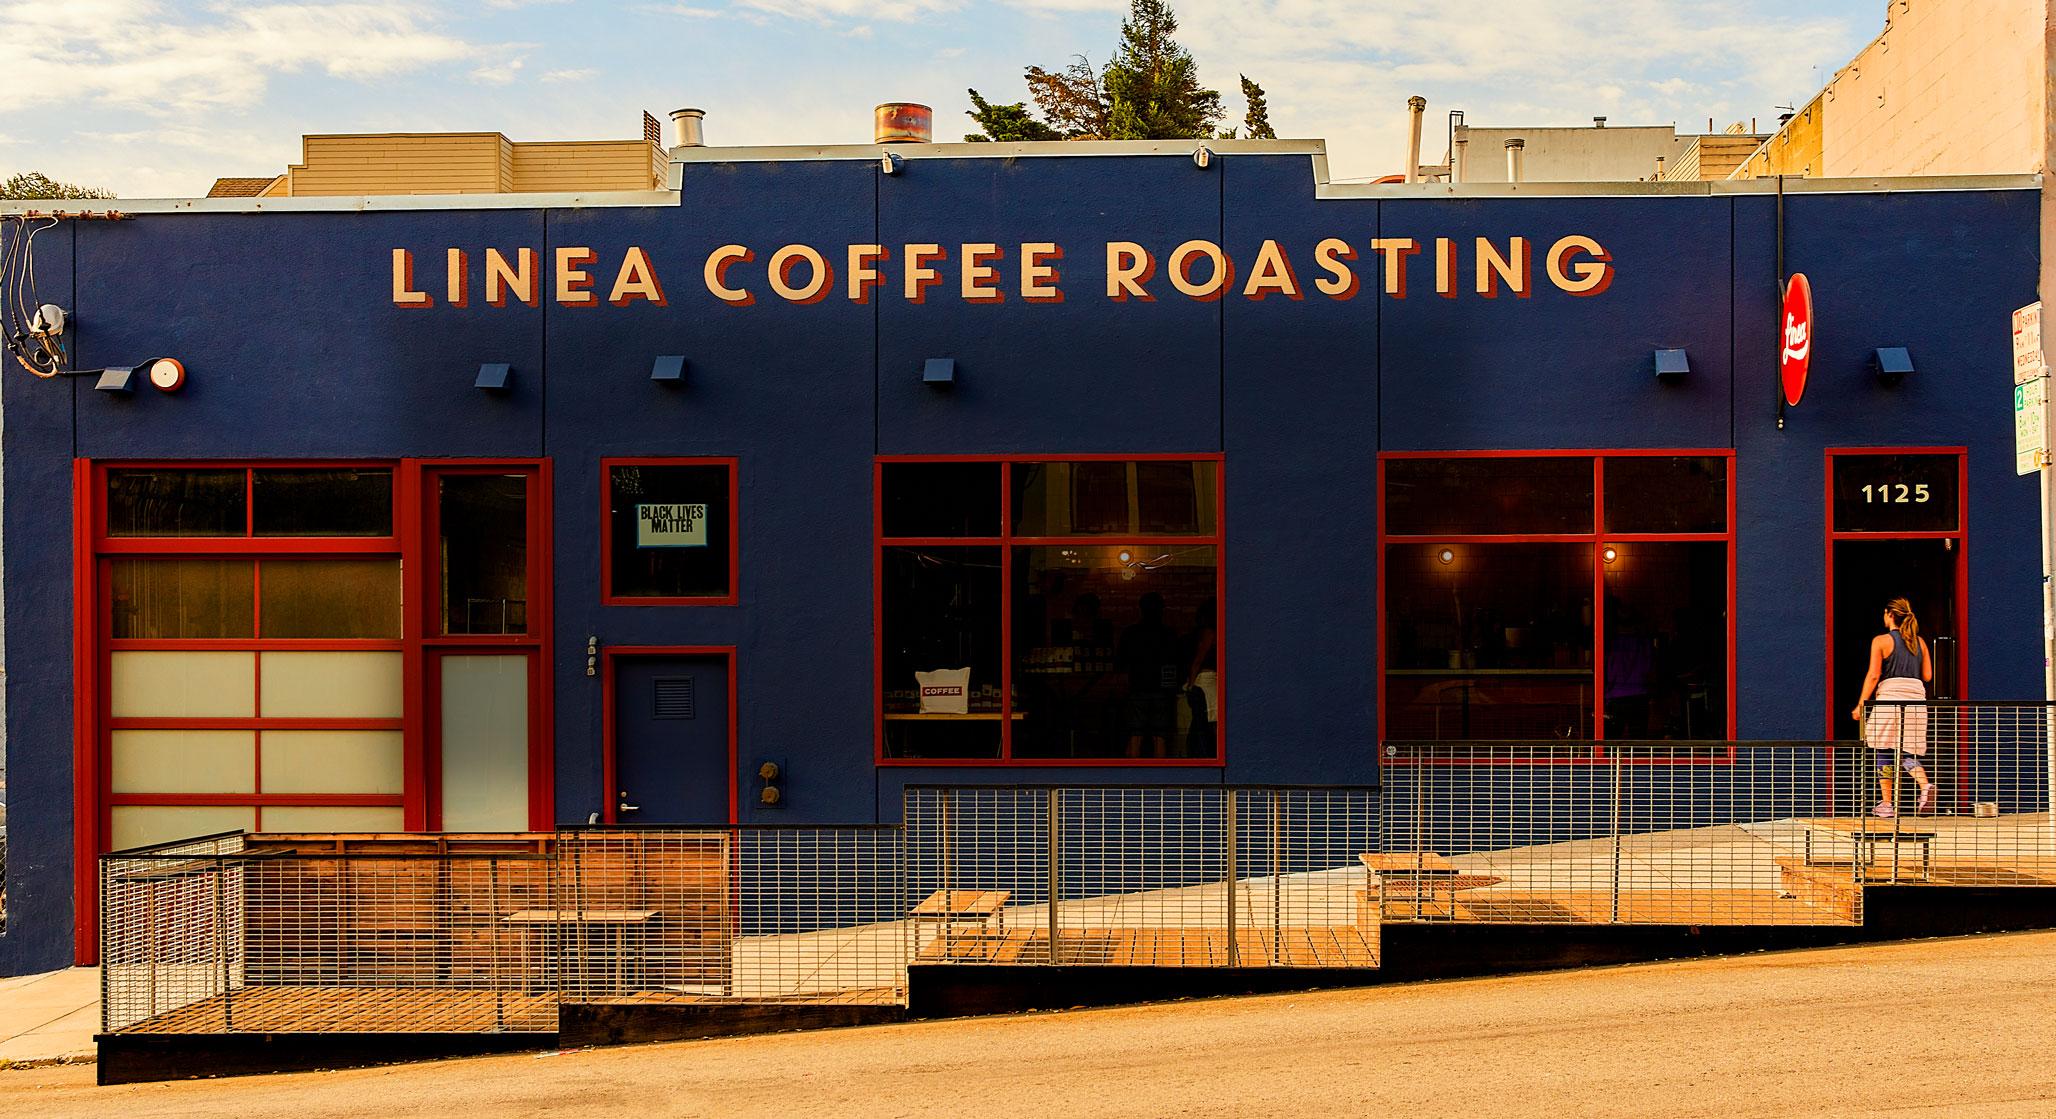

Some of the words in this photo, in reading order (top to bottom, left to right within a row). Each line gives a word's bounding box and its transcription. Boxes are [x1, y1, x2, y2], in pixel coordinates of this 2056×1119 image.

[393, 246, 665, 305] LINEA
[704, 244, 1060, 304] COFFEE
[1106, 235, 1611, 300] ROASTING
[2016, 389, 2022, 407] 2
[1861, 484, 1930, 503] 1125
[640, 505, 673, 519] BLACK
[677, 505, 704, 519] LIVES
[651, 519, 694, 533] MATTER
[924, 687, 961, 696] COFFEE
